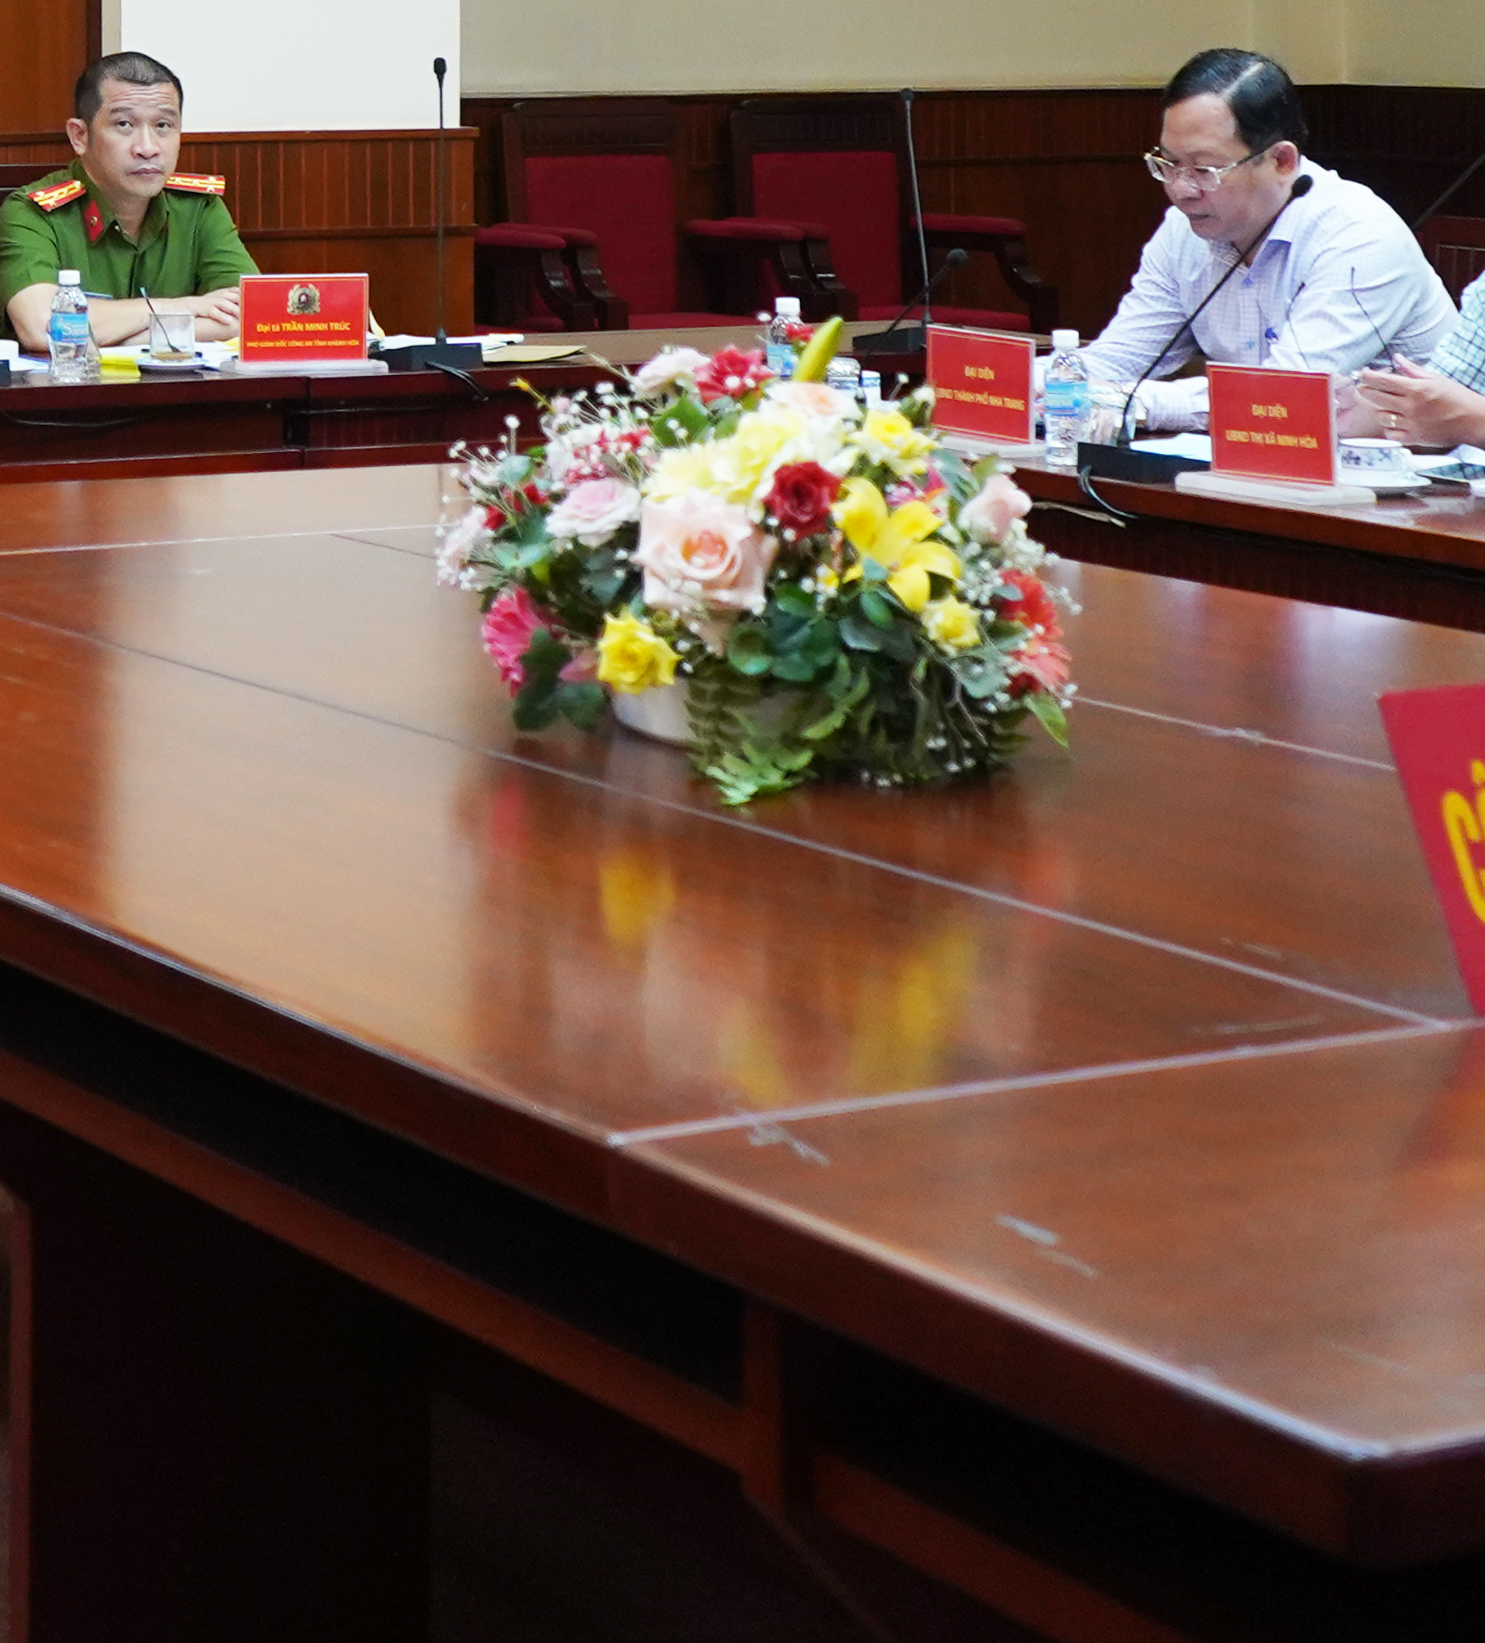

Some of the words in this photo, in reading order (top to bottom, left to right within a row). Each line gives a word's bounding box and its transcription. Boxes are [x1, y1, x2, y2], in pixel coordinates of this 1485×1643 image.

[257, 323, 270, 334] Đại
[272, 324, 280, 332] tá
[282, 321, 303, 331] TRẦN
[305, 322, 328, 331] MINH
[329, 322, 351, 331] TRÚC
